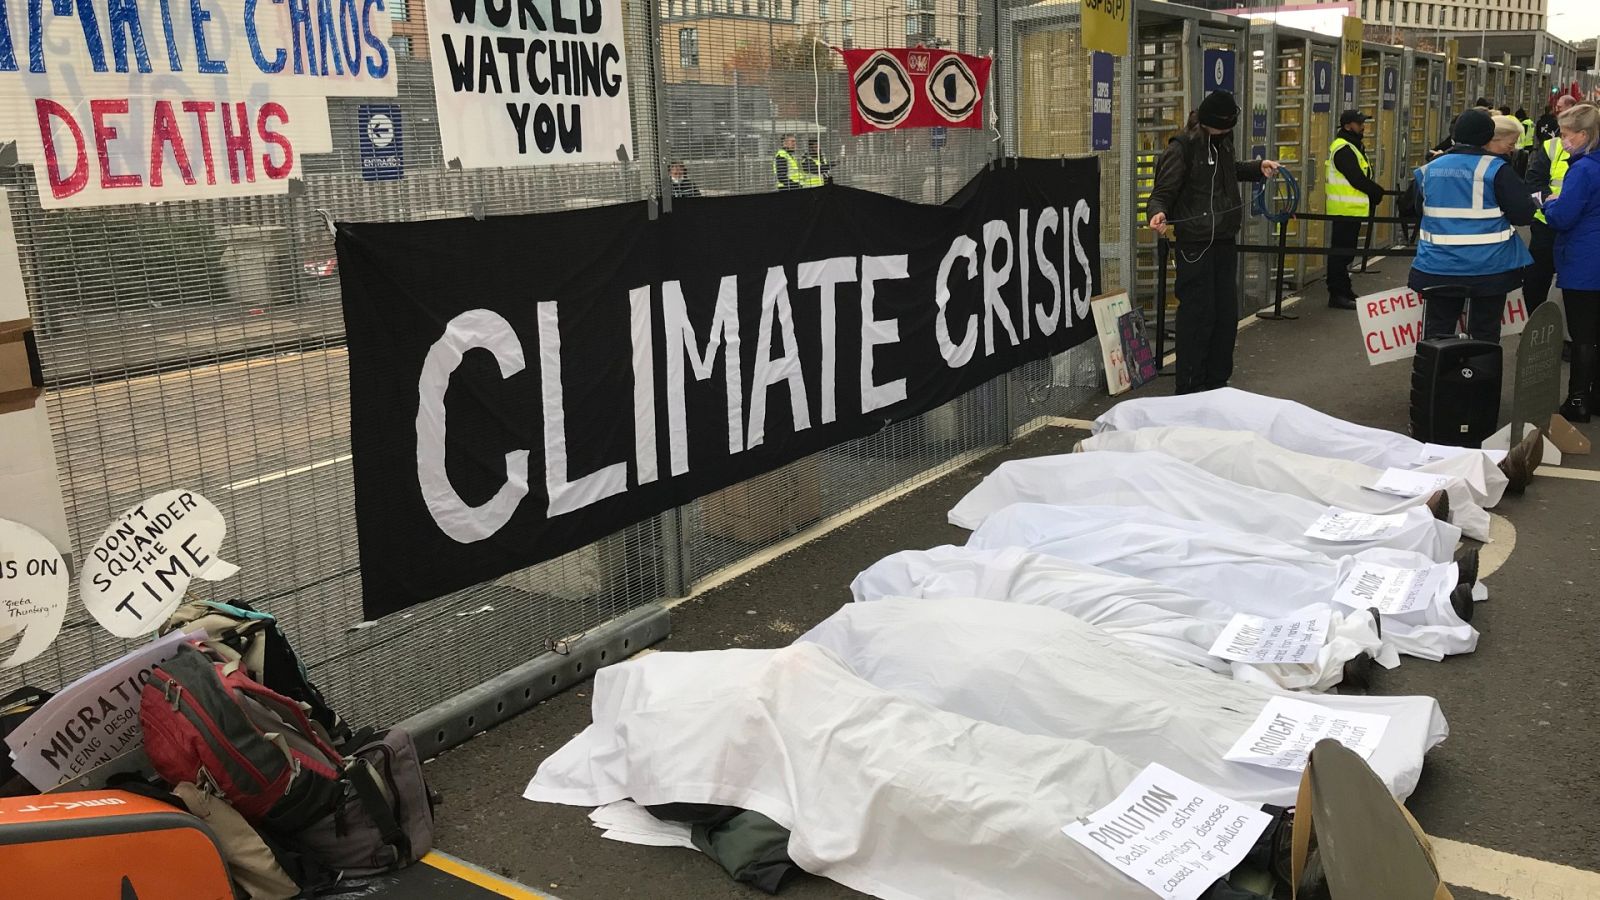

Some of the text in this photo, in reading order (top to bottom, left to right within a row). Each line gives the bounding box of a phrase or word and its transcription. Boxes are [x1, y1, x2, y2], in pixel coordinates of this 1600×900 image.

[244, 0, 389, 78] CHAOS
[451, 0, 602, 34] WORLD
[442, 34, 622, 97] WATCHING
[35, 99, 294, 199] DEATHS
[506, 103, 582, 154] YOU
[1366, 292, 1423, 318] REME
[415, 199, 1092, 544] CLIMATE CRISIS
[92, 492, 197, 592] SQUANDER
[94, 505, 149, 563] DON'T
[132, 541, 168, 574] THE
[26, 558, 58, 576] ON
[115, 533, 210, 620] TIME
[40, 658, 166, 770] MIGRATIO
[1249, 713, 1298, 756] DROUGHT
[1088, 784, 1179, 850] POLLUTION
[1115, 843, 1149, 866] Death
[1172, 796, 1204, 829] asthma
[1196, 803, 1230, 838] diseases
[1162, 866, 1194, 893] caused
[1213, 814, 1250, 856] pollution
